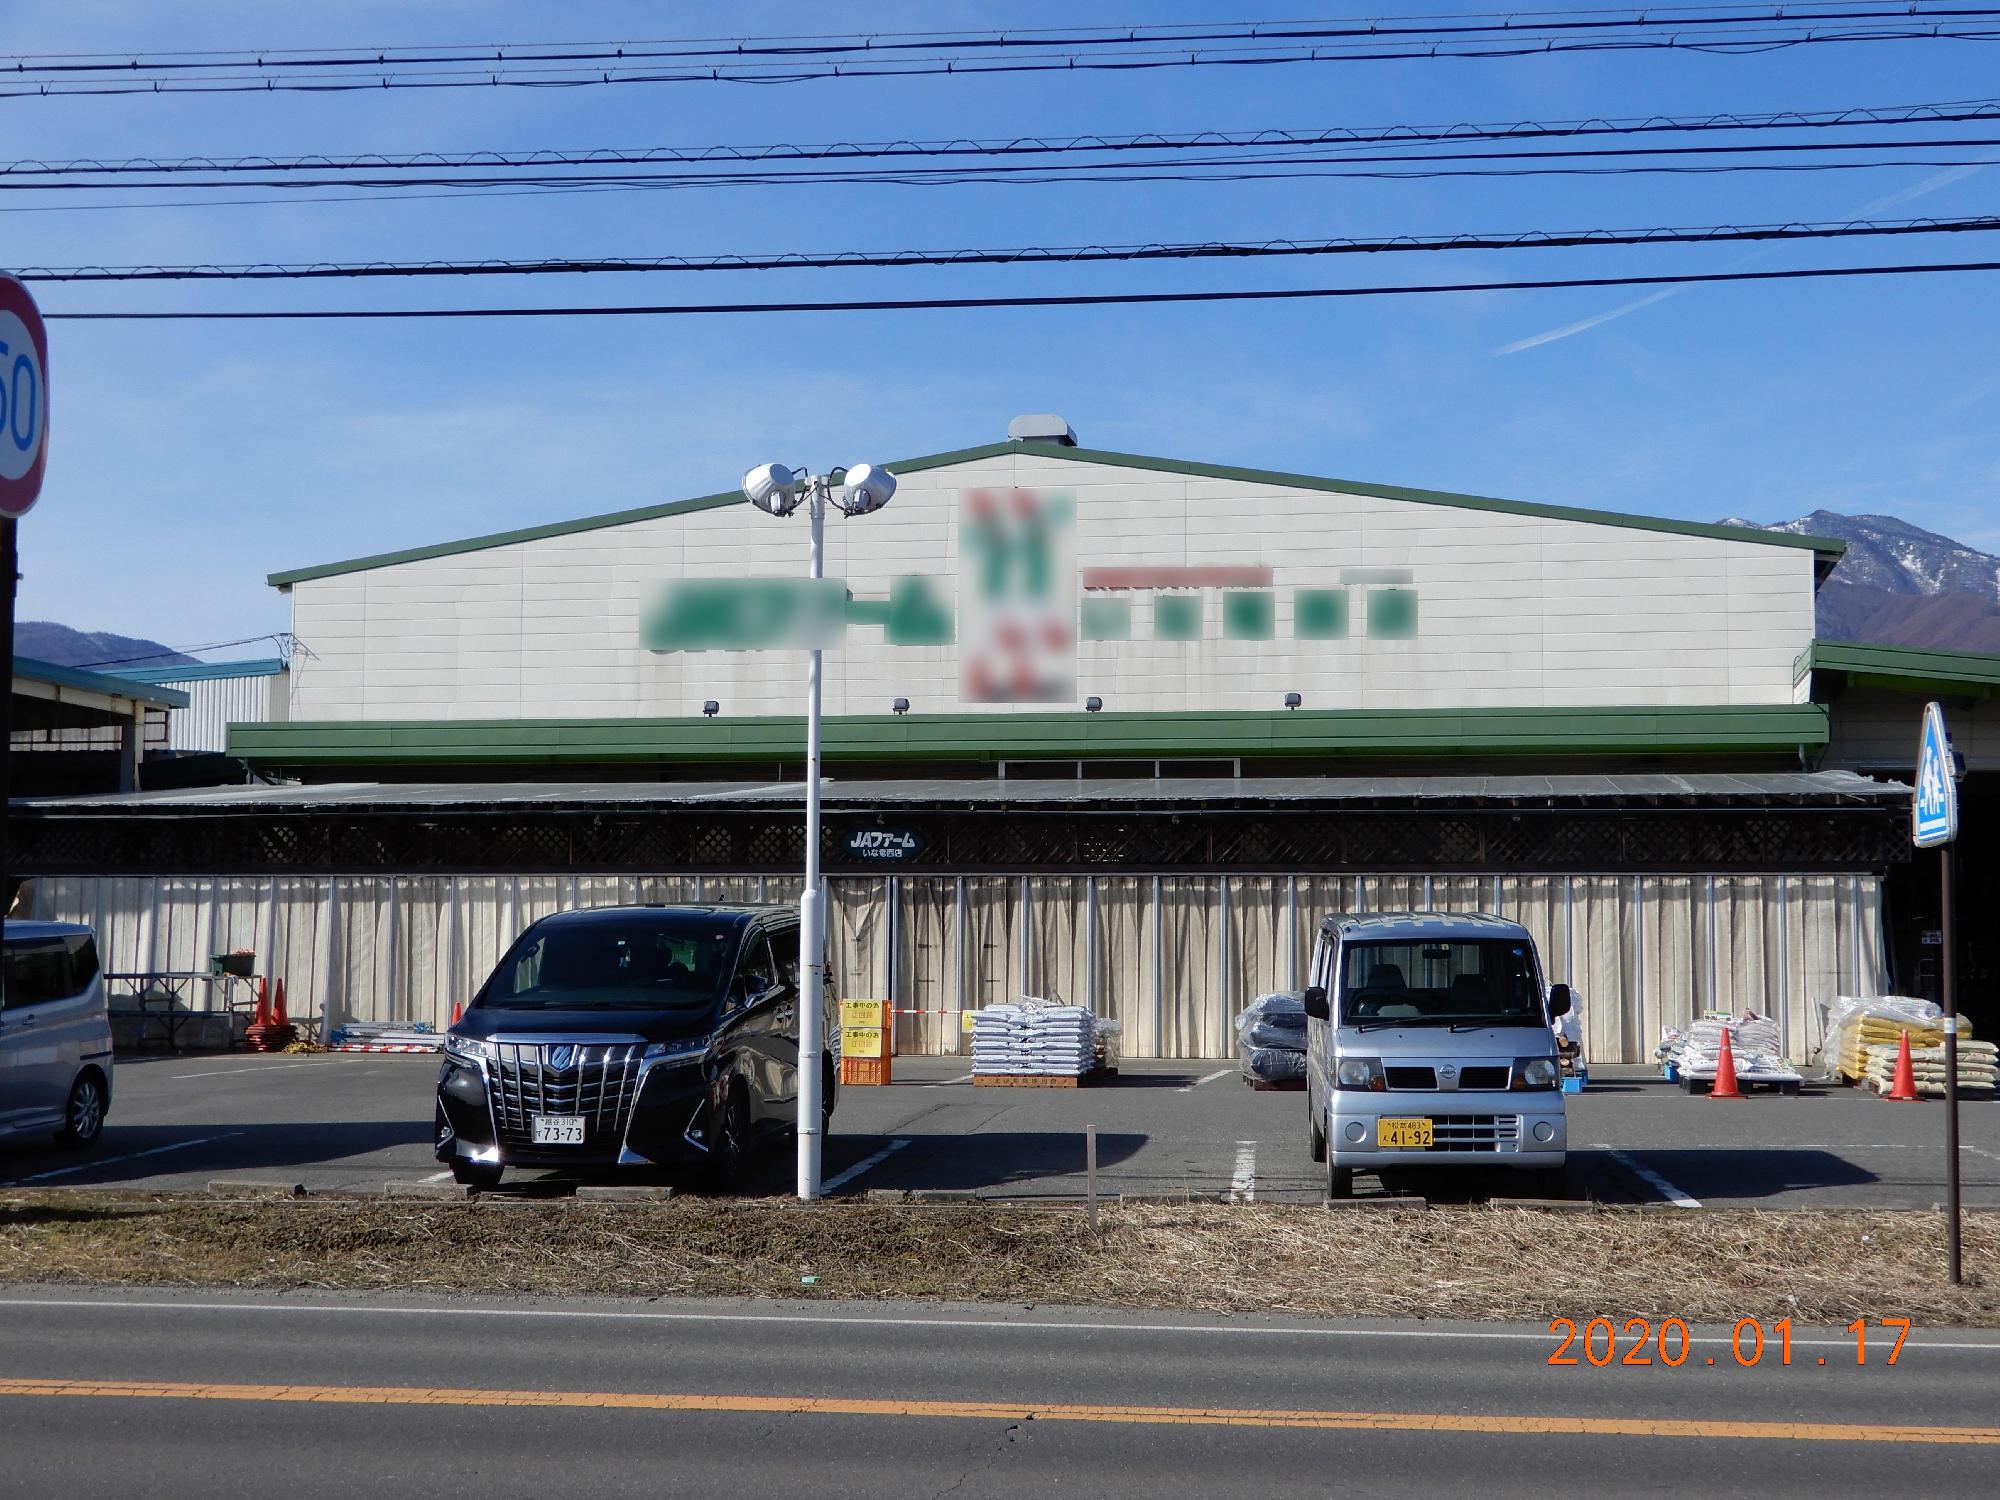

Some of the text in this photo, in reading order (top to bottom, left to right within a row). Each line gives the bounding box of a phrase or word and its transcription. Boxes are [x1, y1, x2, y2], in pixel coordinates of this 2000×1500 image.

[850, 832, 916, 848] JAファーム
[544, 1127, 582, 1141] 73-73
[1390, 1130, 1430, 1145] 41-92
